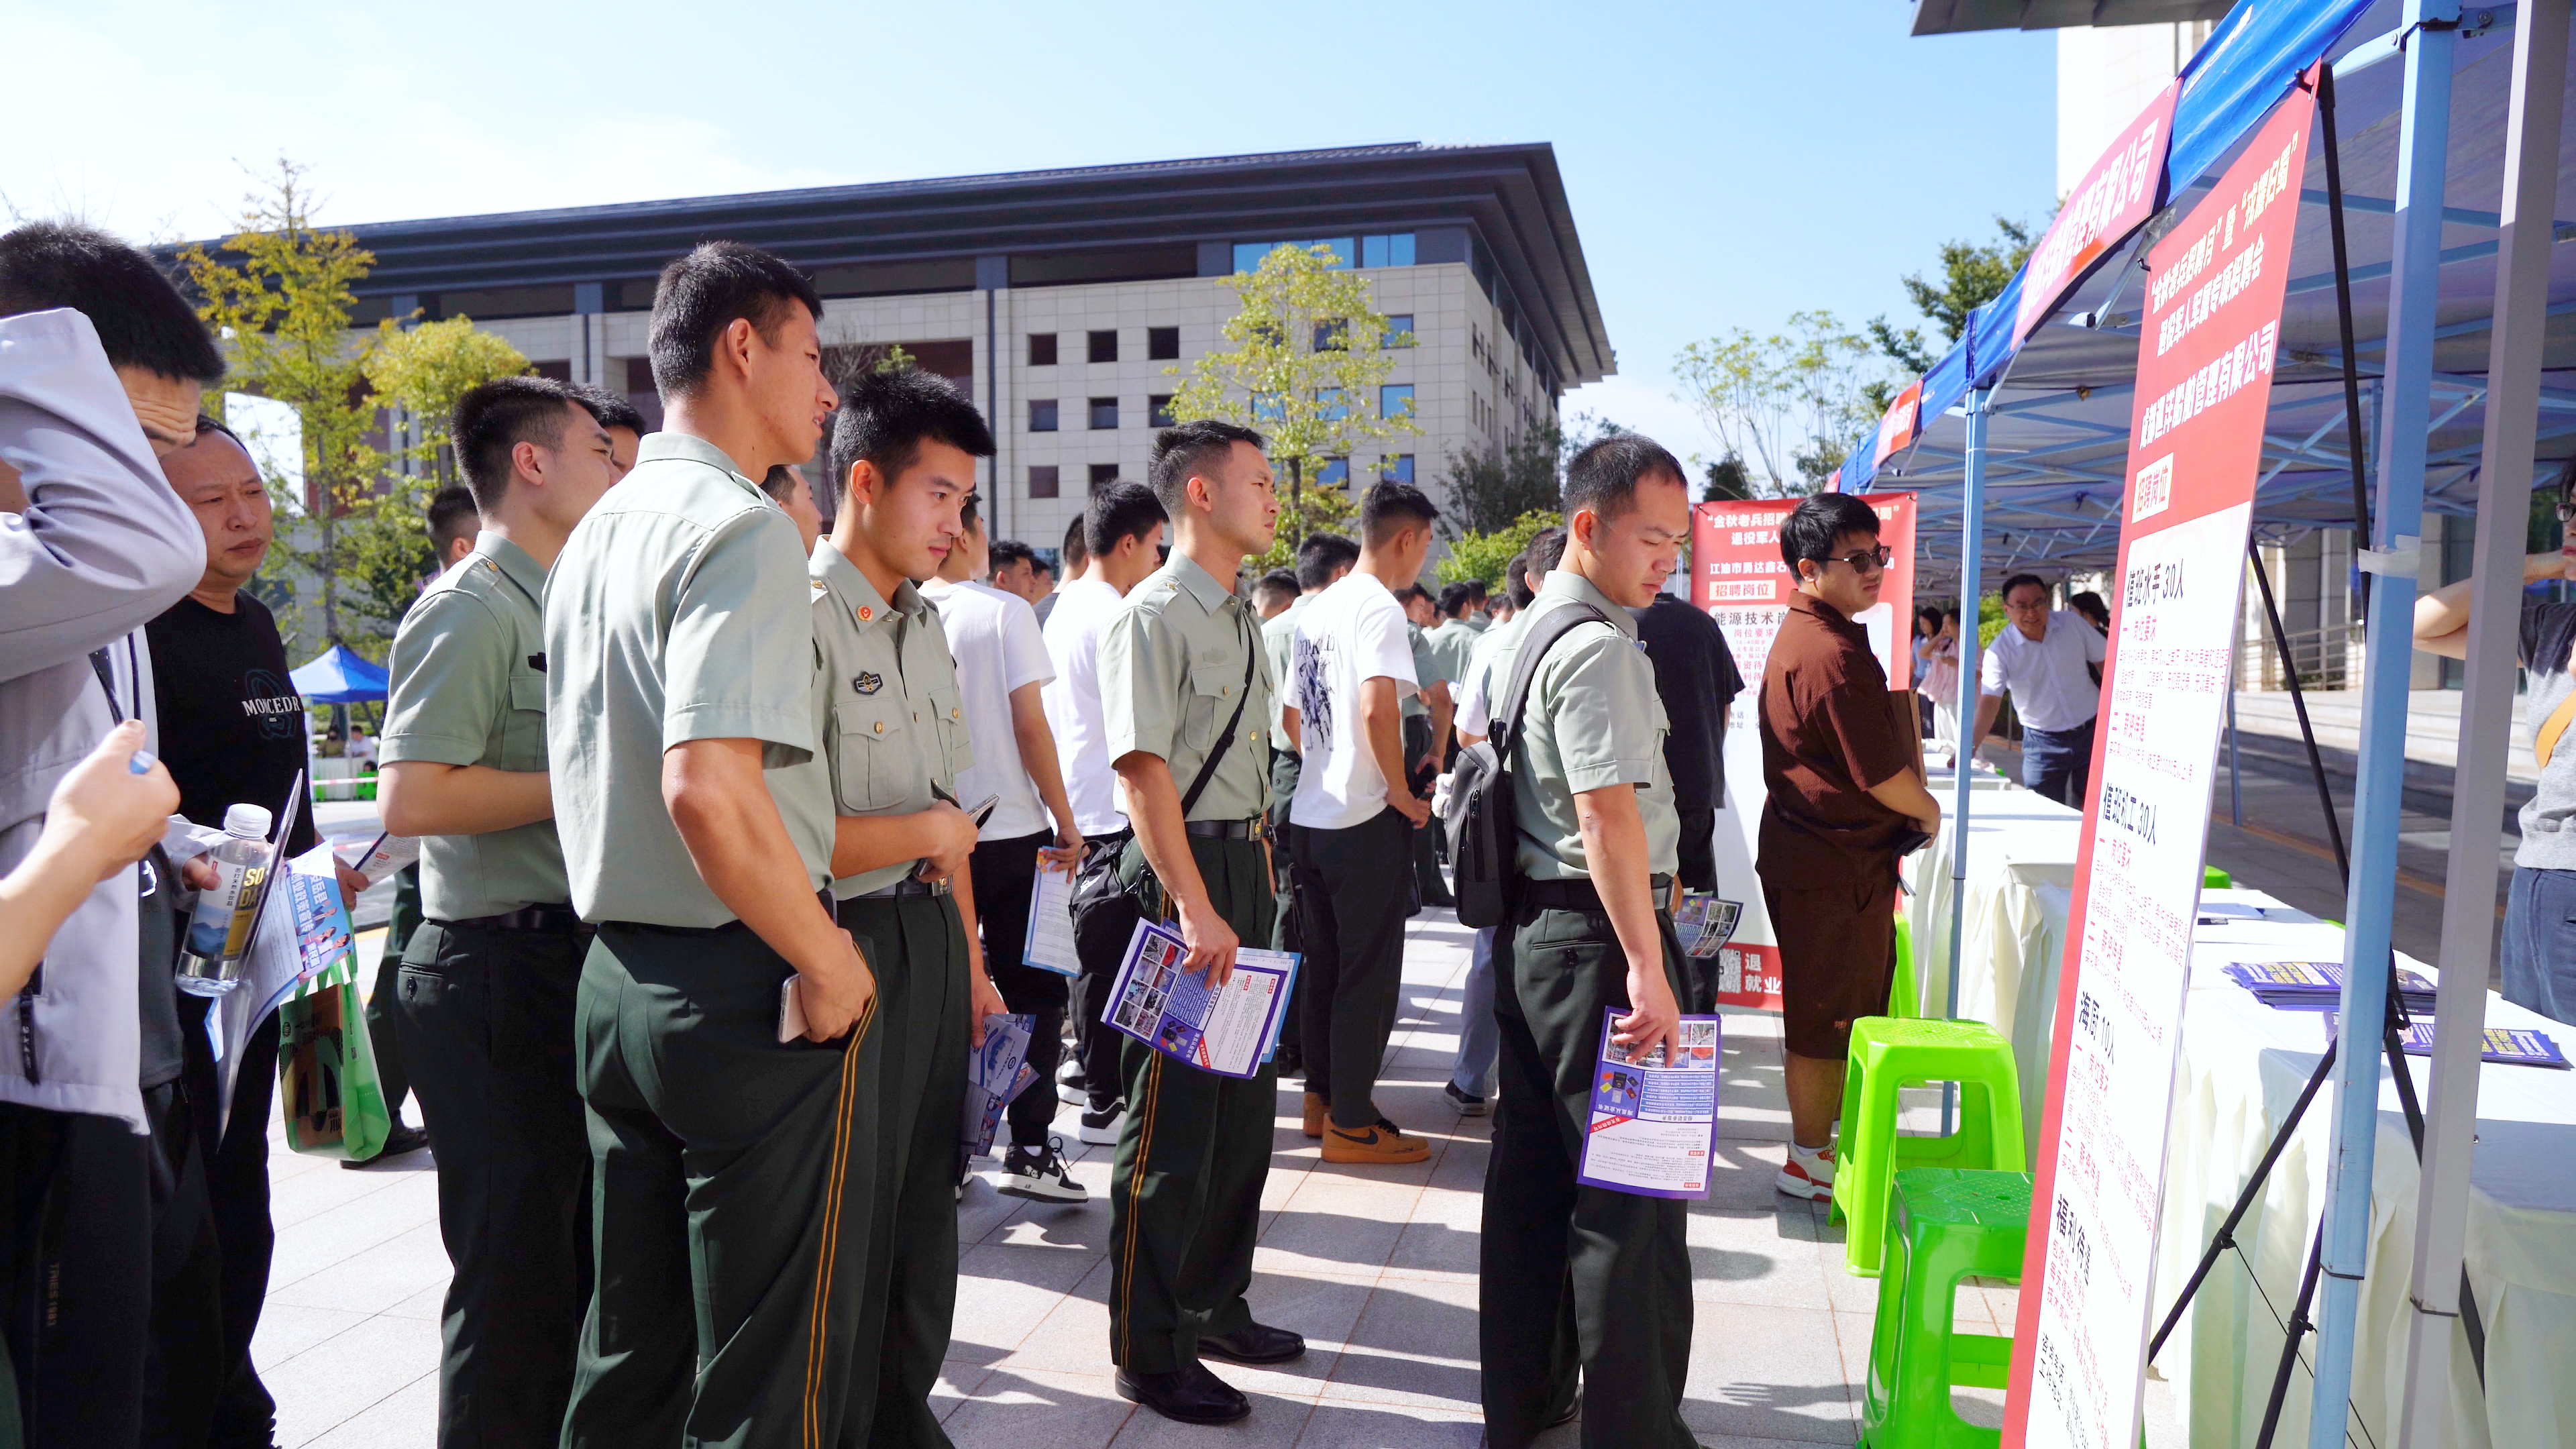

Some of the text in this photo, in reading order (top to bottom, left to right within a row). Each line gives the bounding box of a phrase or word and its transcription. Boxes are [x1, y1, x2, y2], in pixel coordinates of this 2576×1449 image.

[2157, 232, 2265, 358] 退役军人军属专项招聘会
[2136, 465, 2168, 514] 招聘岗位
[1710, 561, 1790, 574] 江油市勇达鑫石
[1716, 584, 1769, 596] 招聘岗位
[2127, 558, 2184, 608] 值班水手 30人
[1734, 629, 1774, 637] 岗位要求
[2101, 781, 2160, 847] 值班机工 30人
[244, 867, 265, 888] SO
[239, 888, 258, 908] DA
[1745, 953, 1762, 971] 退
[1745, 974, 1782, 995] 就业
[2078, 987, 2117, 1065] 海厨 10人
[2055, 1189, 2092, 1287] 福利待遇
